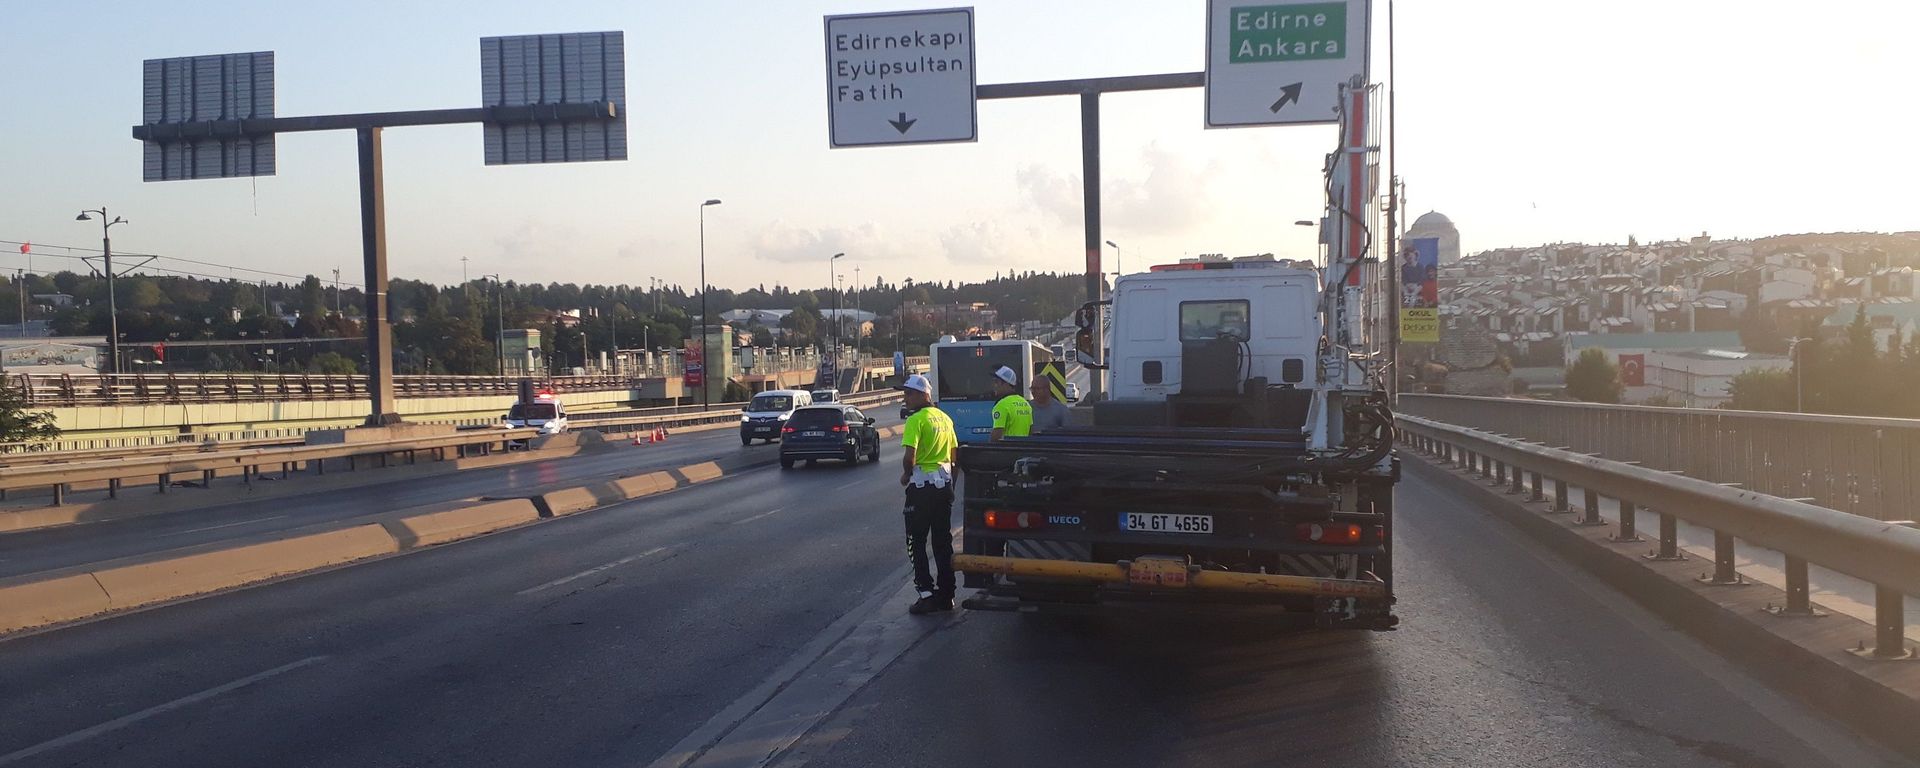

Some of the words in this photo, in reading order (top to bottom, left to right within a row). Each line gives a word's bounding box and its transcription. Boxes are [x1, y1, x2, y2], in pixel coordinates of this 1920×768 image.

[1237, 11, 1327, 31] Edirne
[836, 30, 963, 51] Edirnekapı
[1238, 37, 1338, 57] Ankara
[837, 56, 963, 80] Eyüpsultan
[838, 83, 903, 102] Fatih
[1048, 515, 1081, 525] IVECO
[1129, 514, 1146, 530] 34
[1151, 515, 1169, 531] GT
[1174, 516, 1209, 532] 4656
